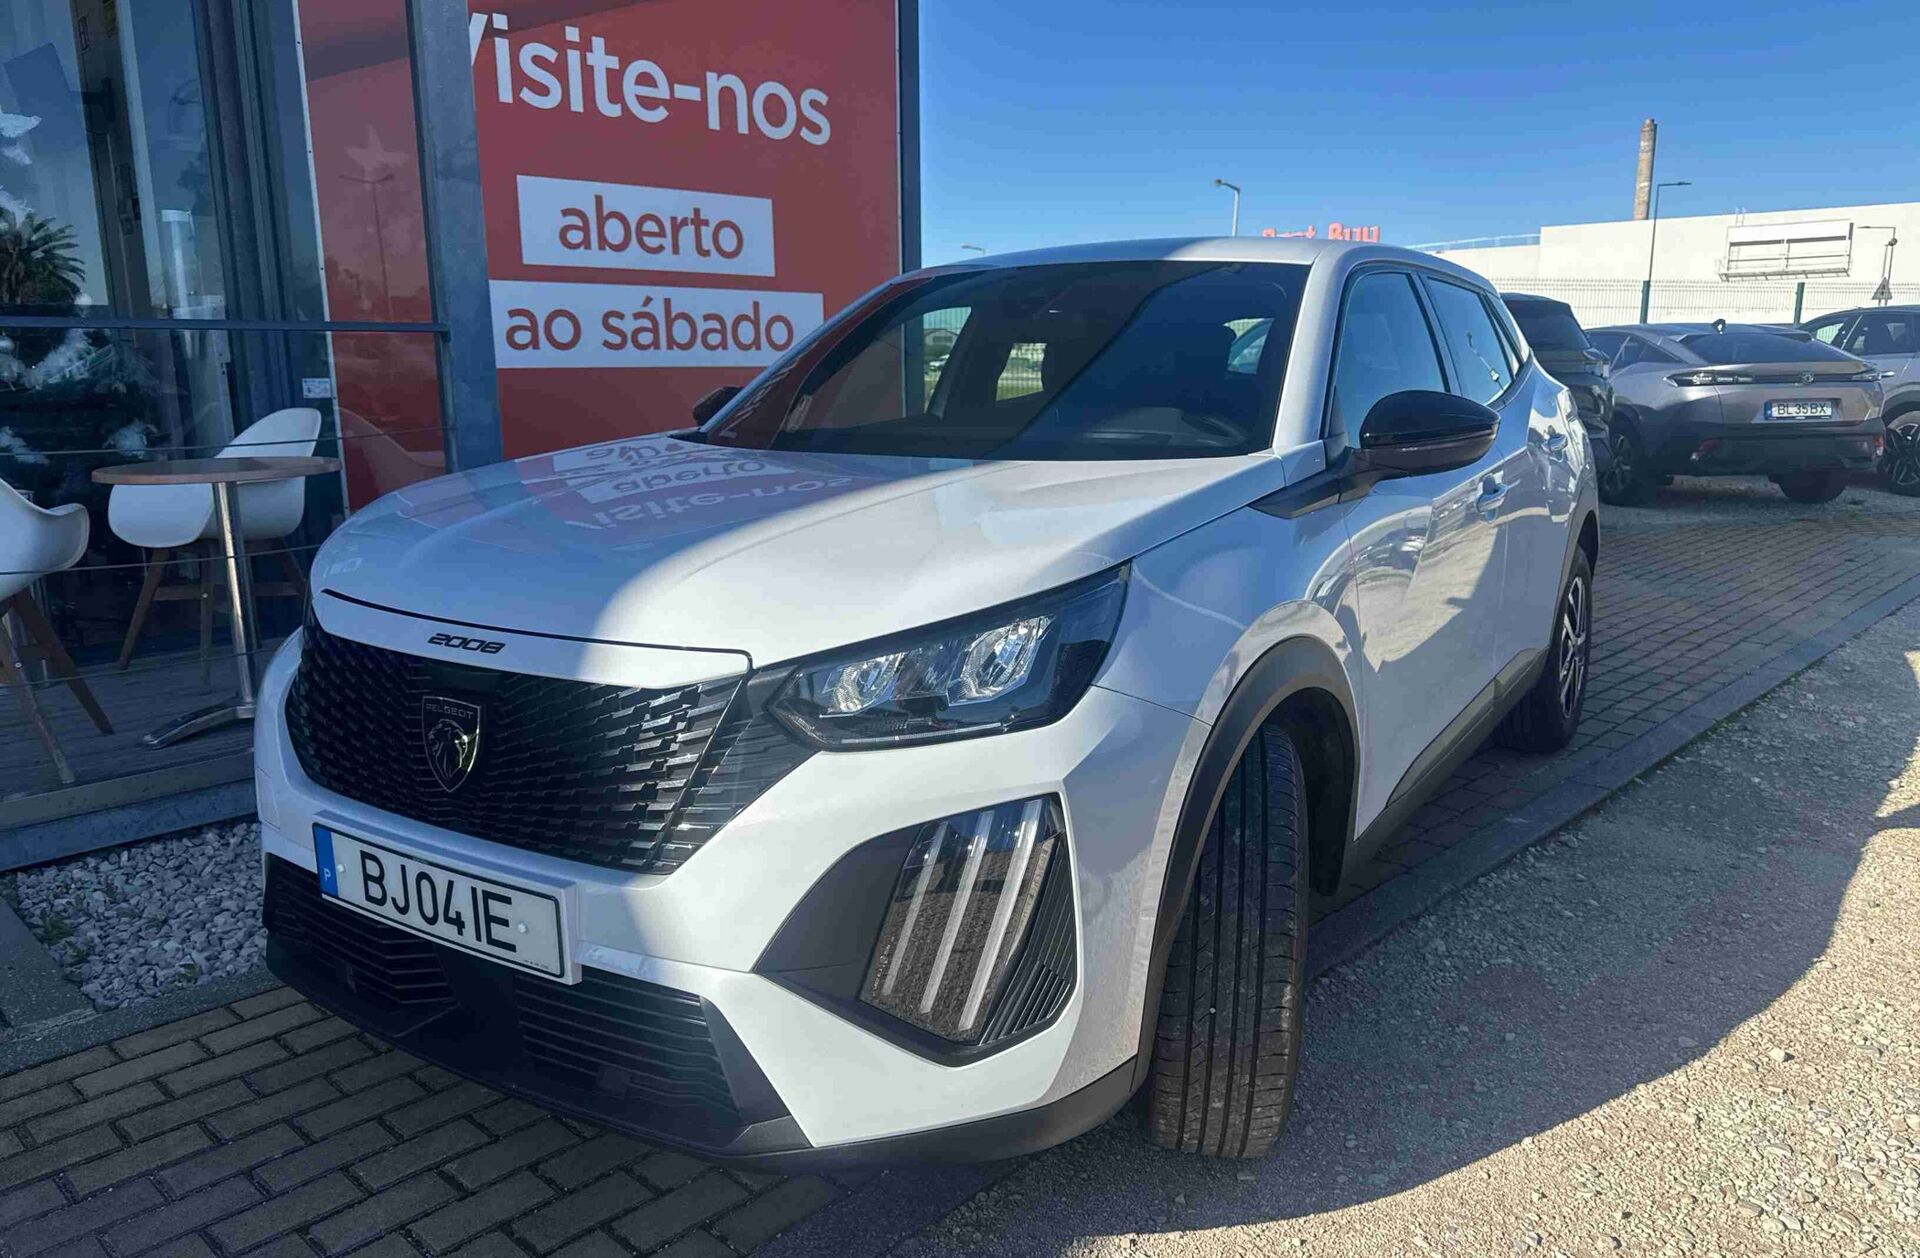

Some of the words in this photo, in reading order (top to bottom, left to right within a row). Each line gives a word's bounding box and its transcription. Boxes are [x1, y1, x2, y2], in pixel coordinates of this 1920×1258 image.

[558, 194, 744, 259] aberto
[505, 307, 581, 351] ao
[601, 295, 794, 352] sábado
[427, 632, 506, 655] 2008
[322, 866, 332, 882] P
[360, 849, 517, 954] BJ04IE
